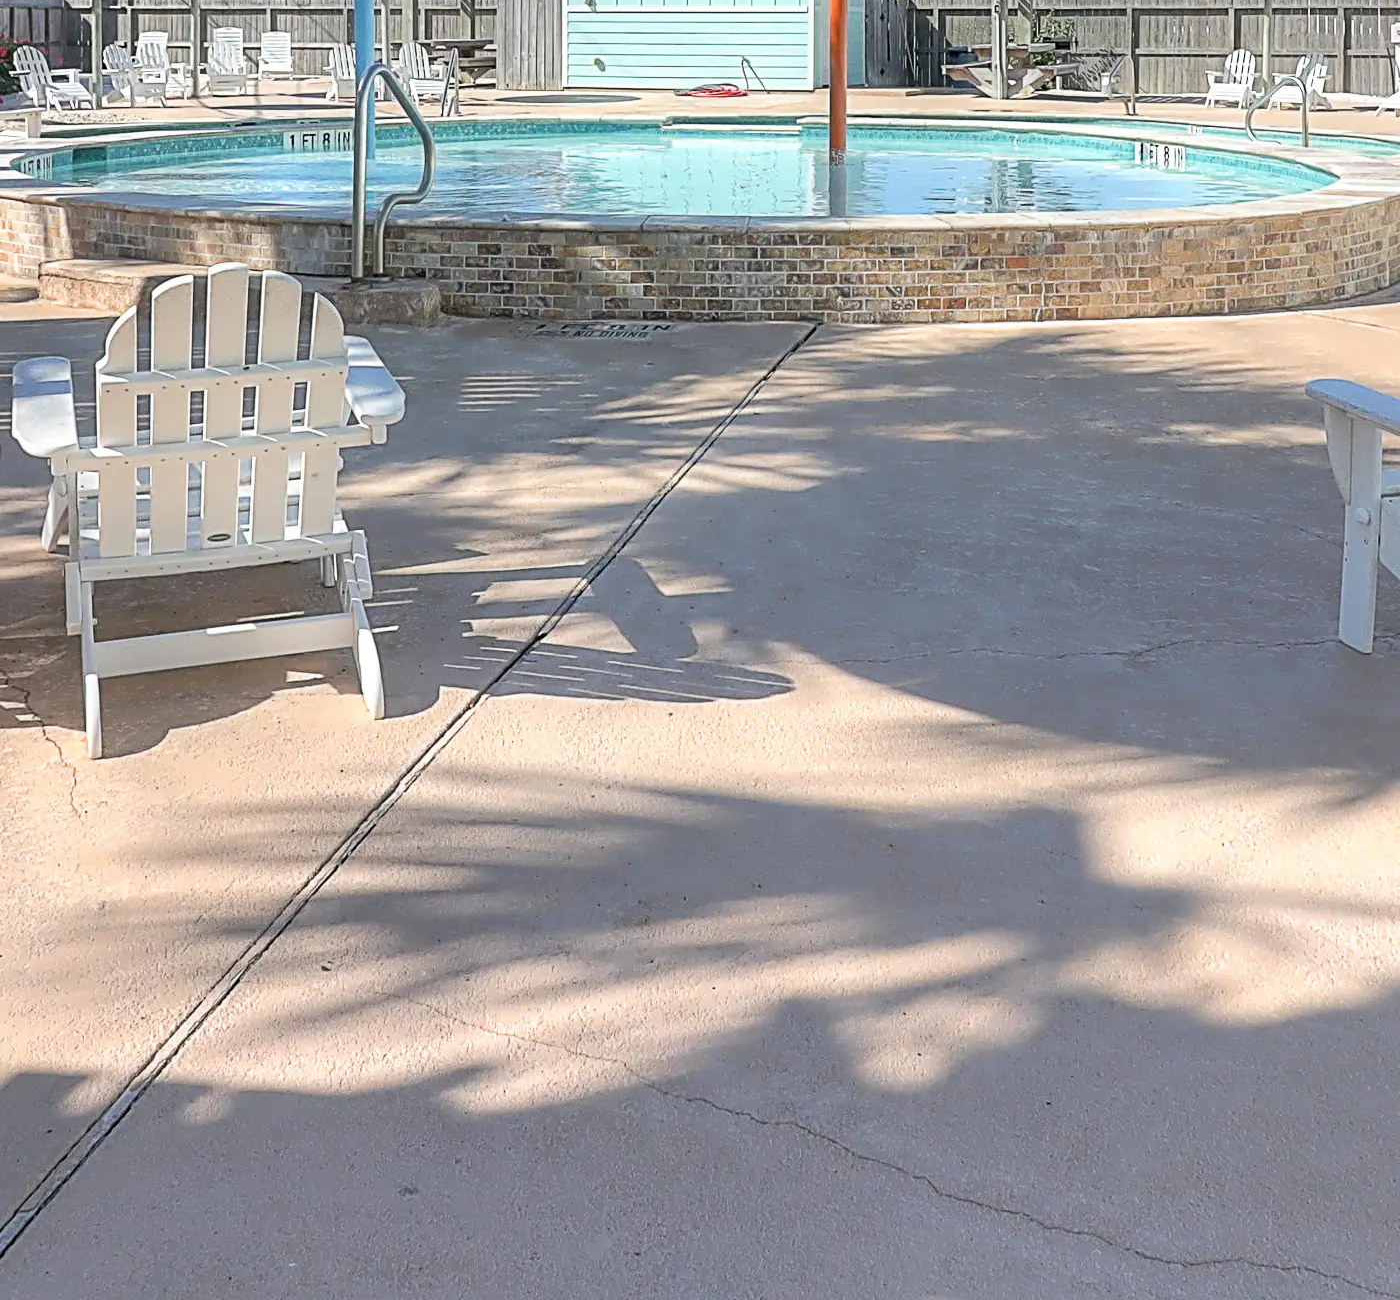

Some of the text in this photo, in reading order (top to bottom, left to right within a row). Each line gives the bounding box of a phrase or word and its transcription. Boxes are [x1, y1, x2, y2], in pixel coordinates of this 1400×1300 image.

[302, 133, 317, 152] FT
[322, 132, 331, 152] 8
[337, 131, 350, 152] IN
[1163, 145, 1170, 164] 8
[641, 323, 672, 331] IN
[599, 330, 651, 338] DIVING
